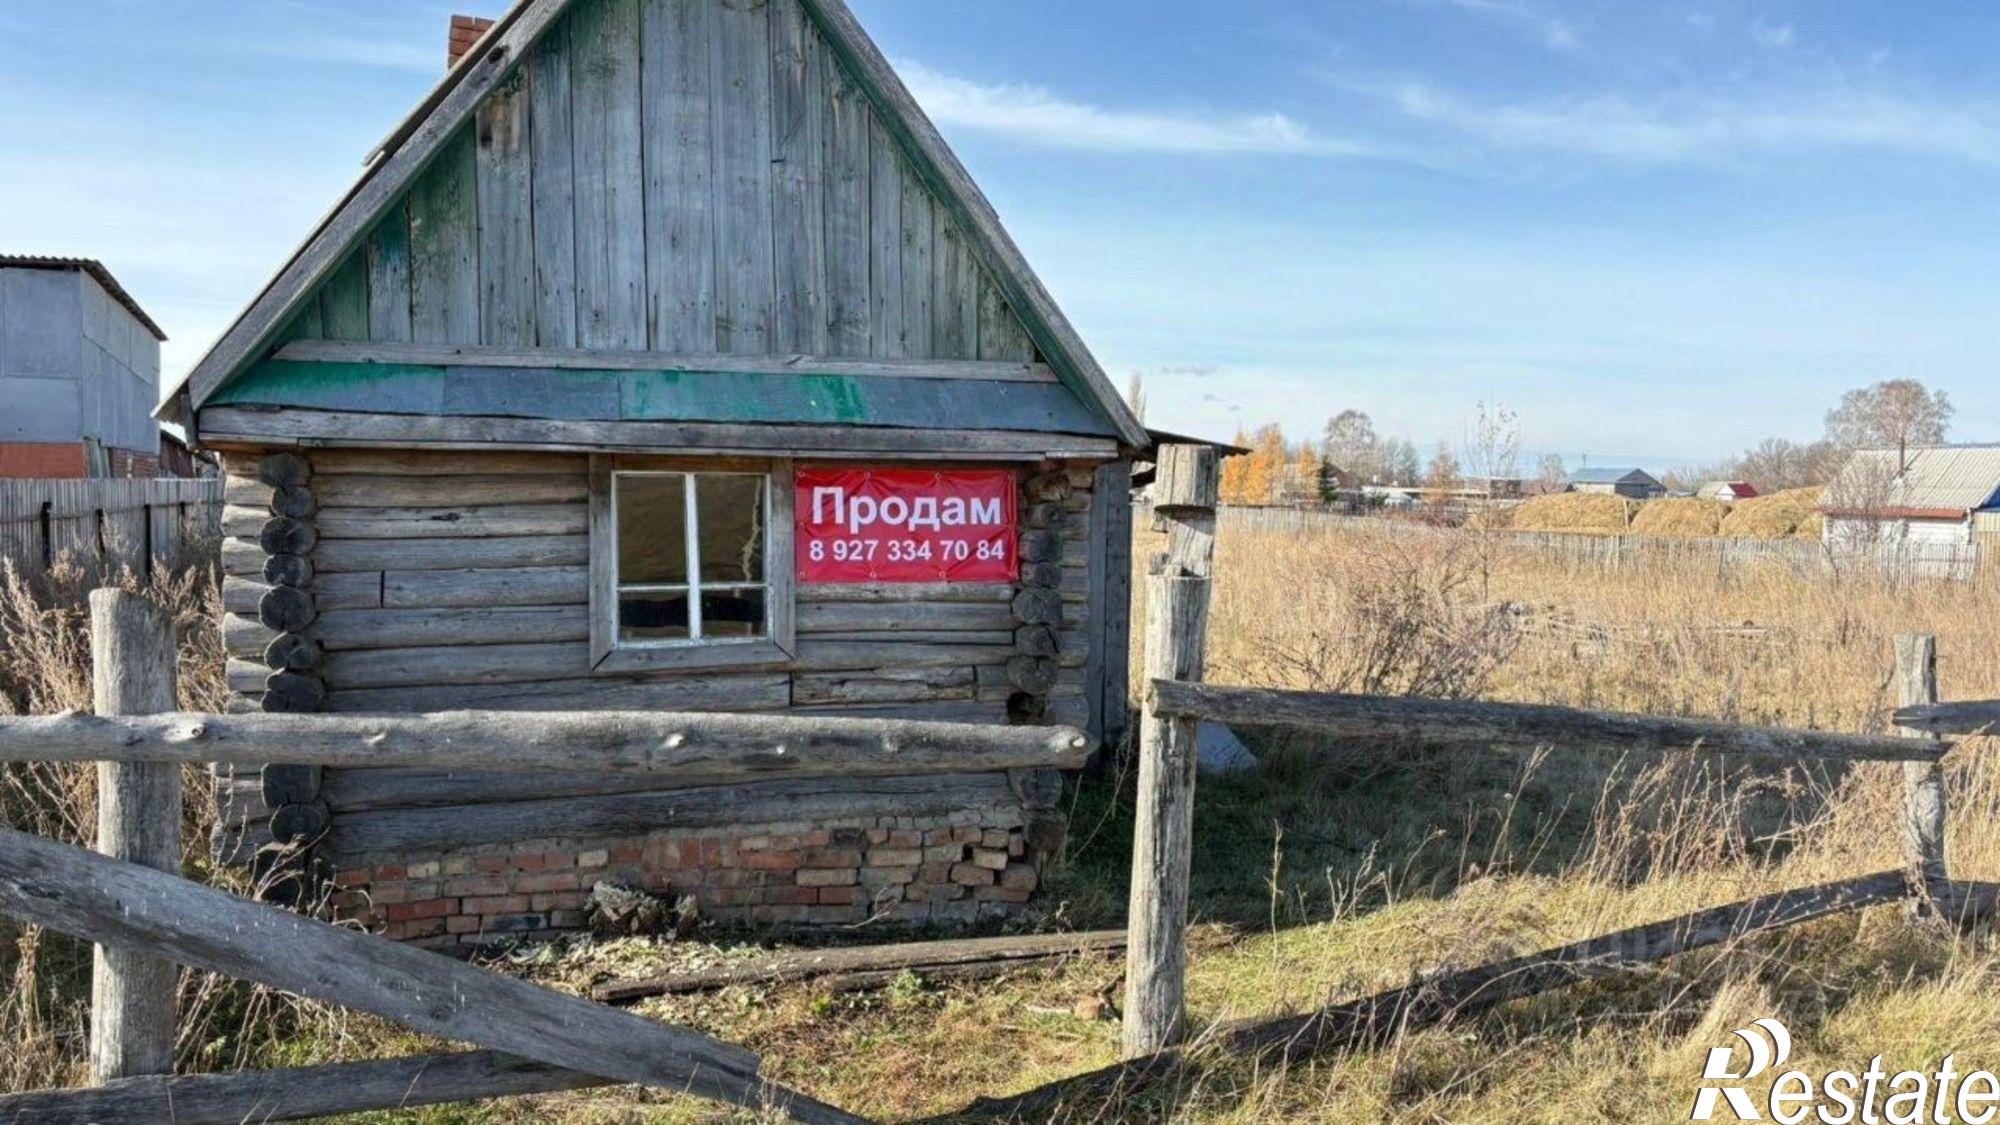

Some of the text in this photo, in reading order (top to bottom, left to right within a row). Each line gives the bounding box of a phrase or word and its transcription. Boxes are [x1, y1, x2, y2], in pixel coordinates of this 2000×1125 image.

[812, 486, 1001, 534] Продам
[809, 540, 1005, 561] 8 927 334 70 84
